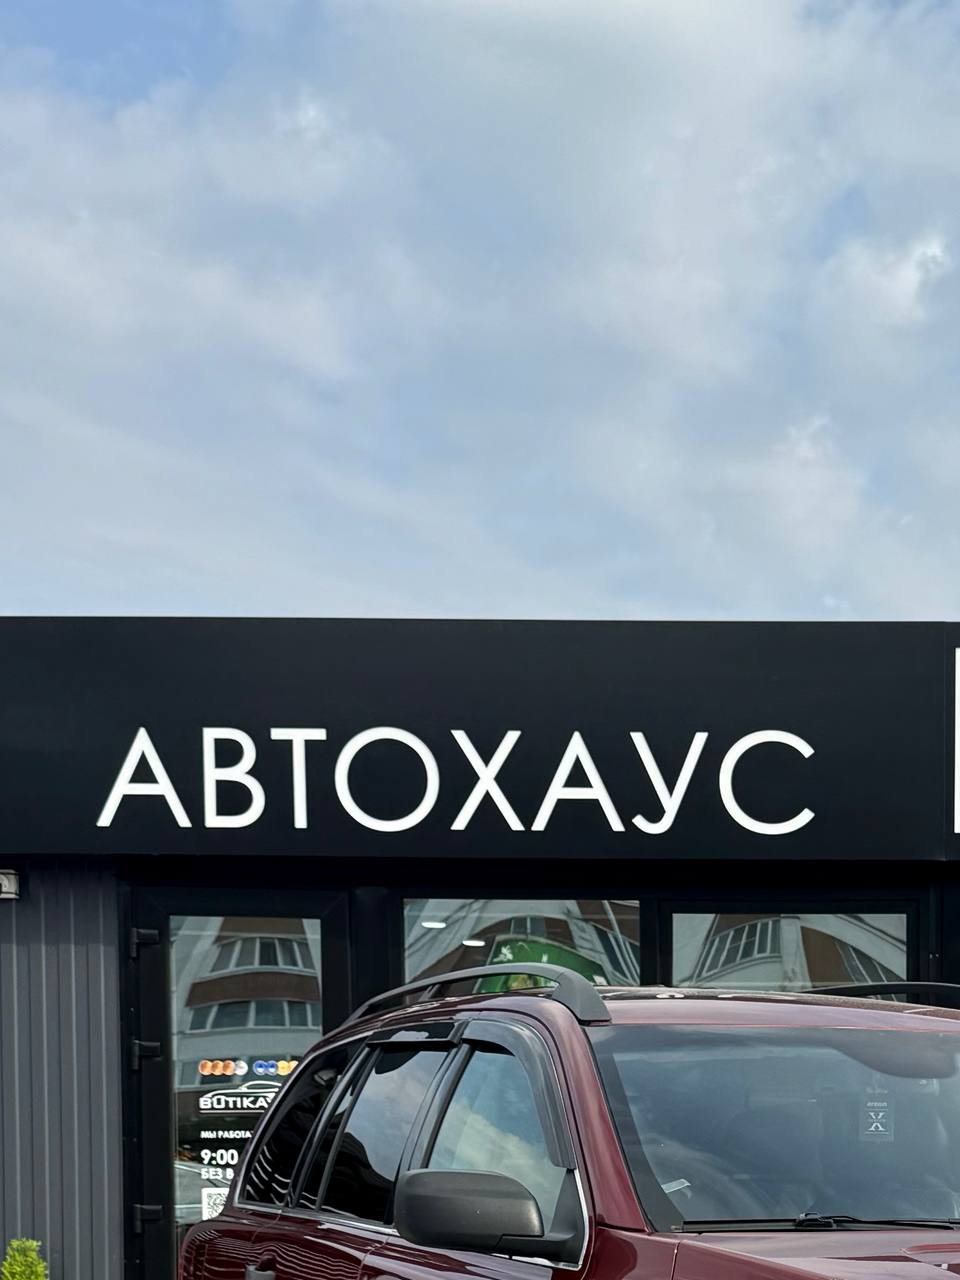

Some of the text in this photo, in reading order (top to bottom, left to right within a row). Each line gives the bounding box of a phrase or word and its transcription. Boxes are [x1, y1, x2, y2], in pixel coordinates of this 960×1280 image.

[96, 726, 816, 835] АВТОХАУС
[200, 1130, 254, 1139] МЫ РАБОТА
[200, 1149, 239, 1165] 9:00
[201, 1168, 223, 1179] БЕЗ
